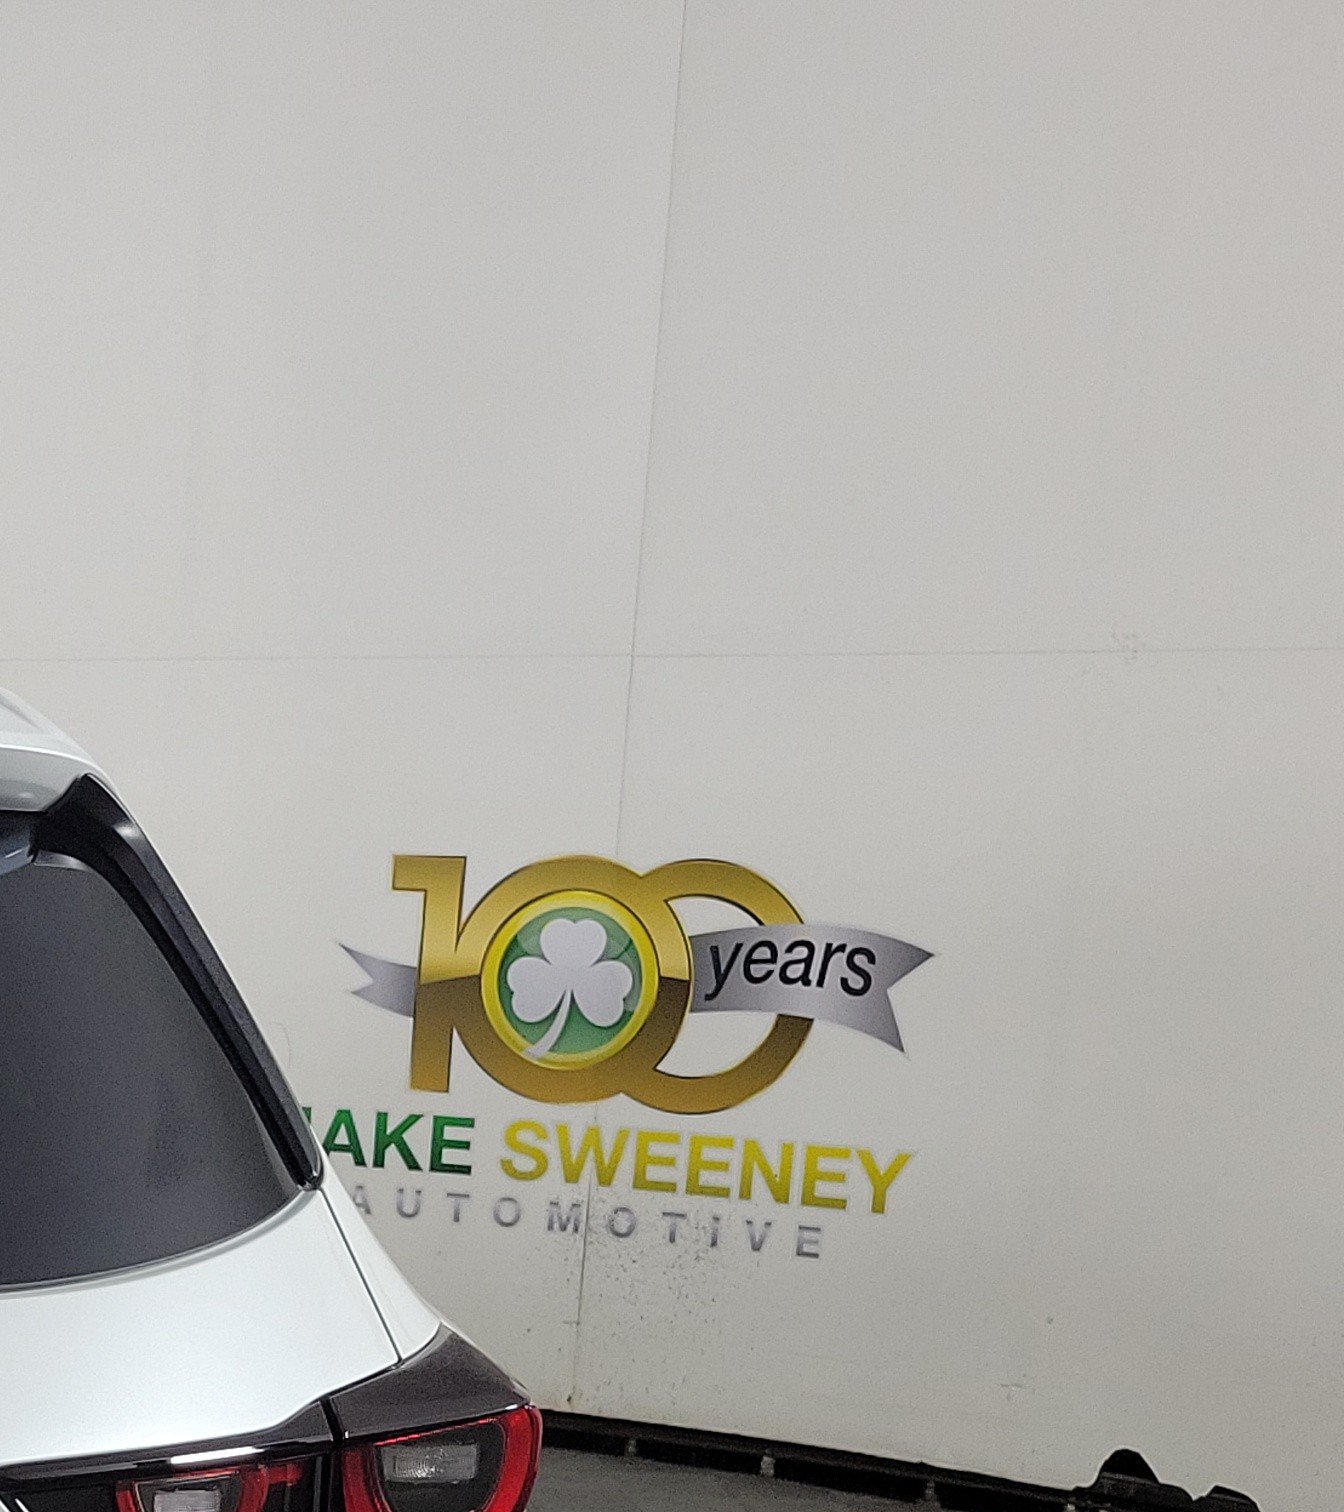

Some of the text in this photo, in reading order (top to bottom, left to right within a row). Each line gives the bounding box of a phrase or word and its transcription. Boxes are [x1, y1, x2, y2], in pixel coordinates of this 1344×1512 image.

[391, 854, 814, 1116] 100
[704, 938, 877, 1001] years
[301, 1106, 914, 1215] AKE SWEENEY
[352, 1185, 822, 1259] AUTOMOTIVE
